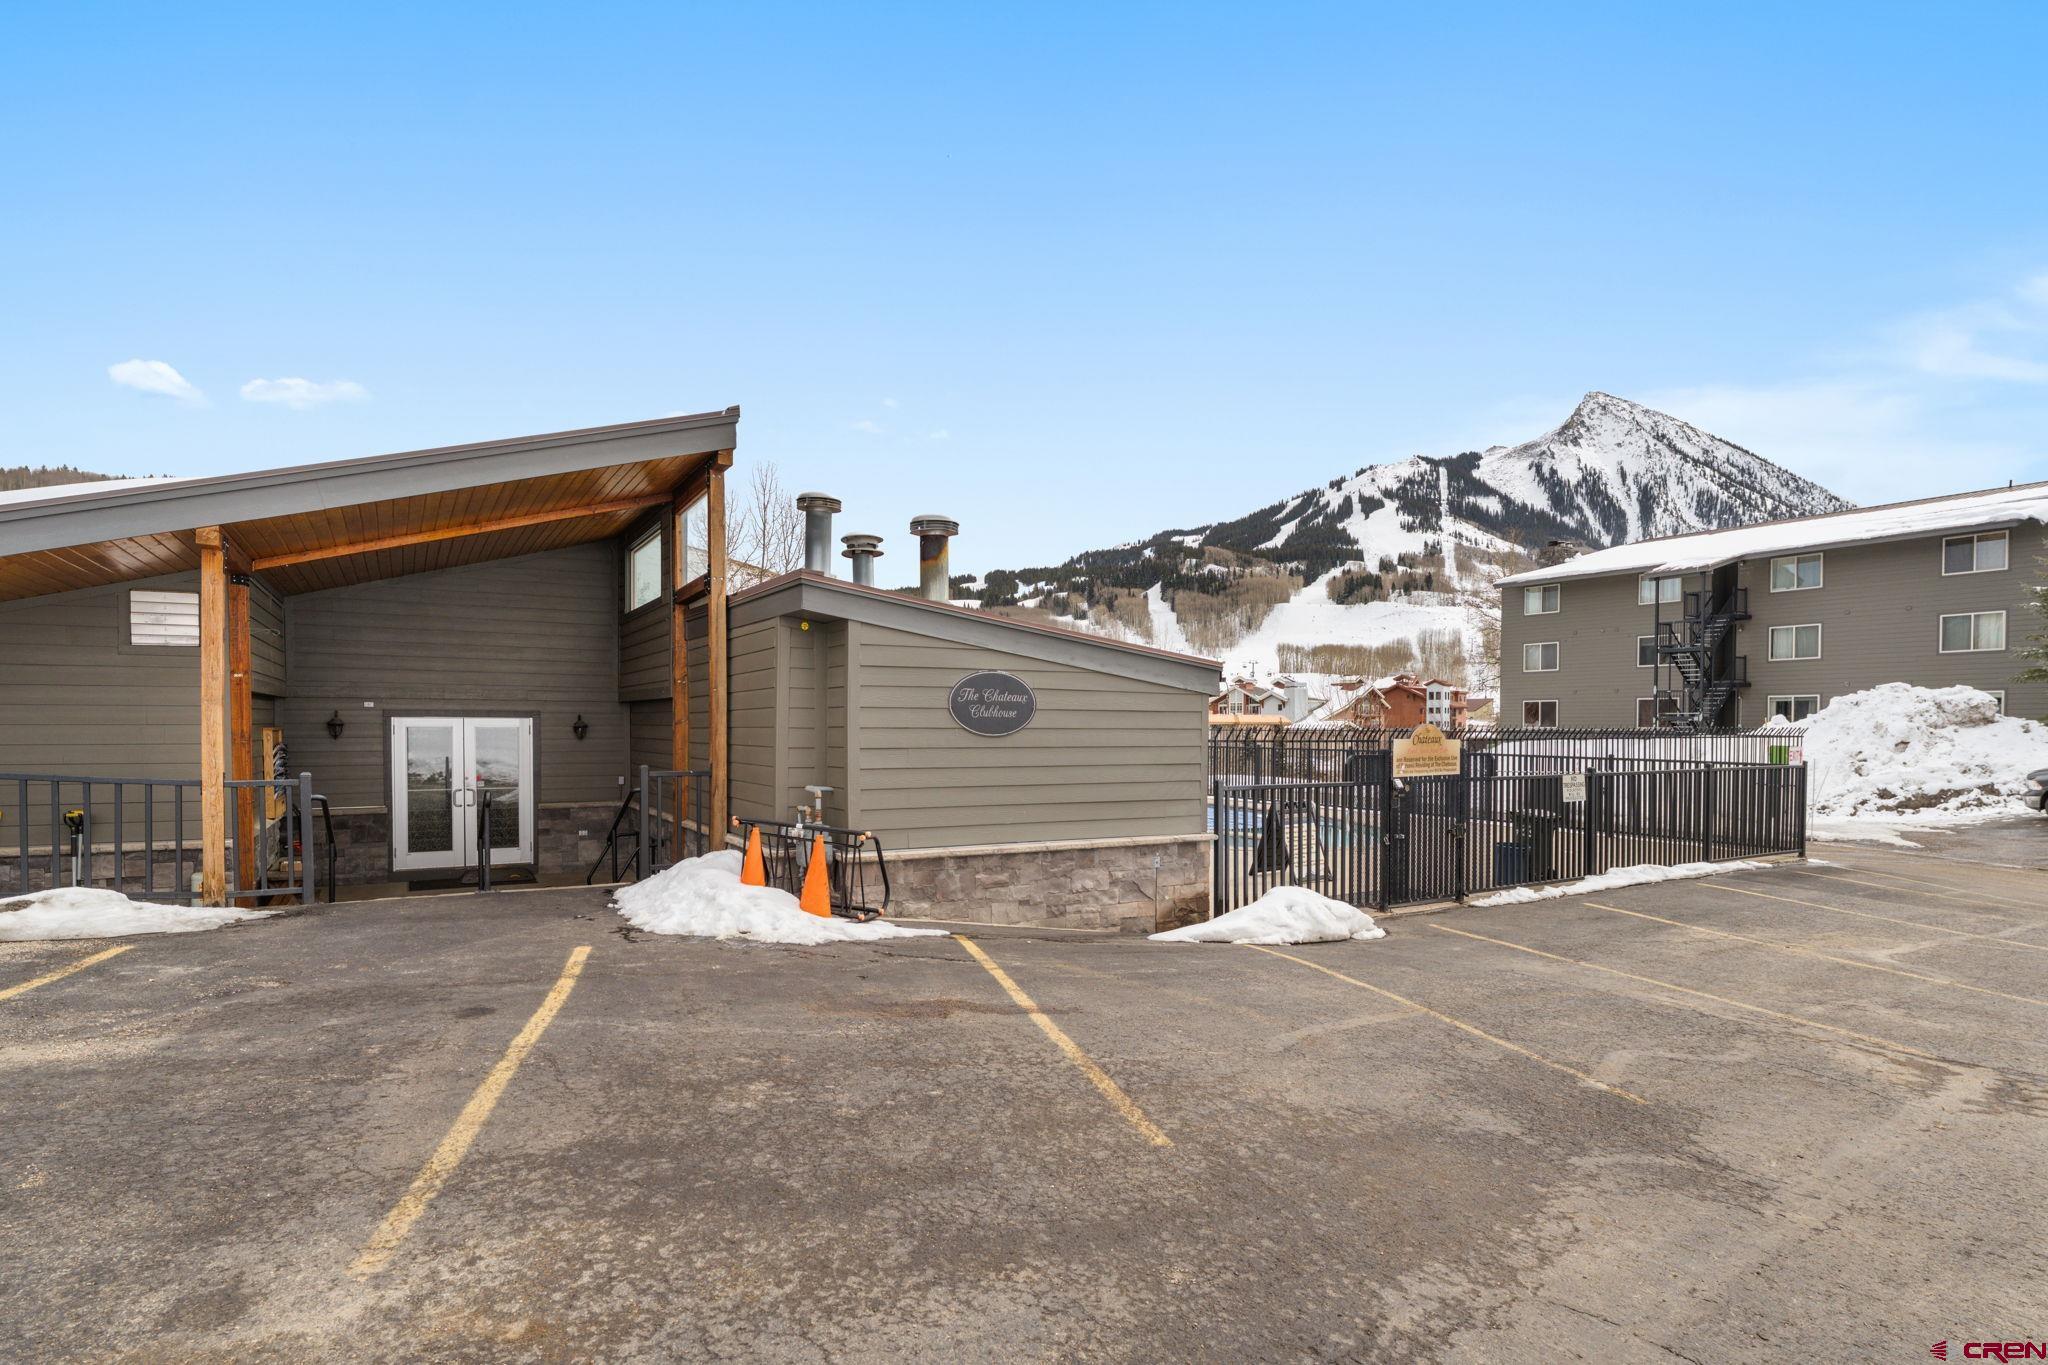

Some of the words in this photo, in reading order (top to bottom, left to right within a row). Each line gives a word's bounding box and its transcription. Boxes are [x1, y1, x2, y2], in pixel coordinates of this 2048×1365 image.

[958, 688, 979, 702] The
[982, 689, 1028, 704] Chateaux
[969, 704, 1017, 718] Clubhouse
[1412, 734, 1443, 746] Chateaux
